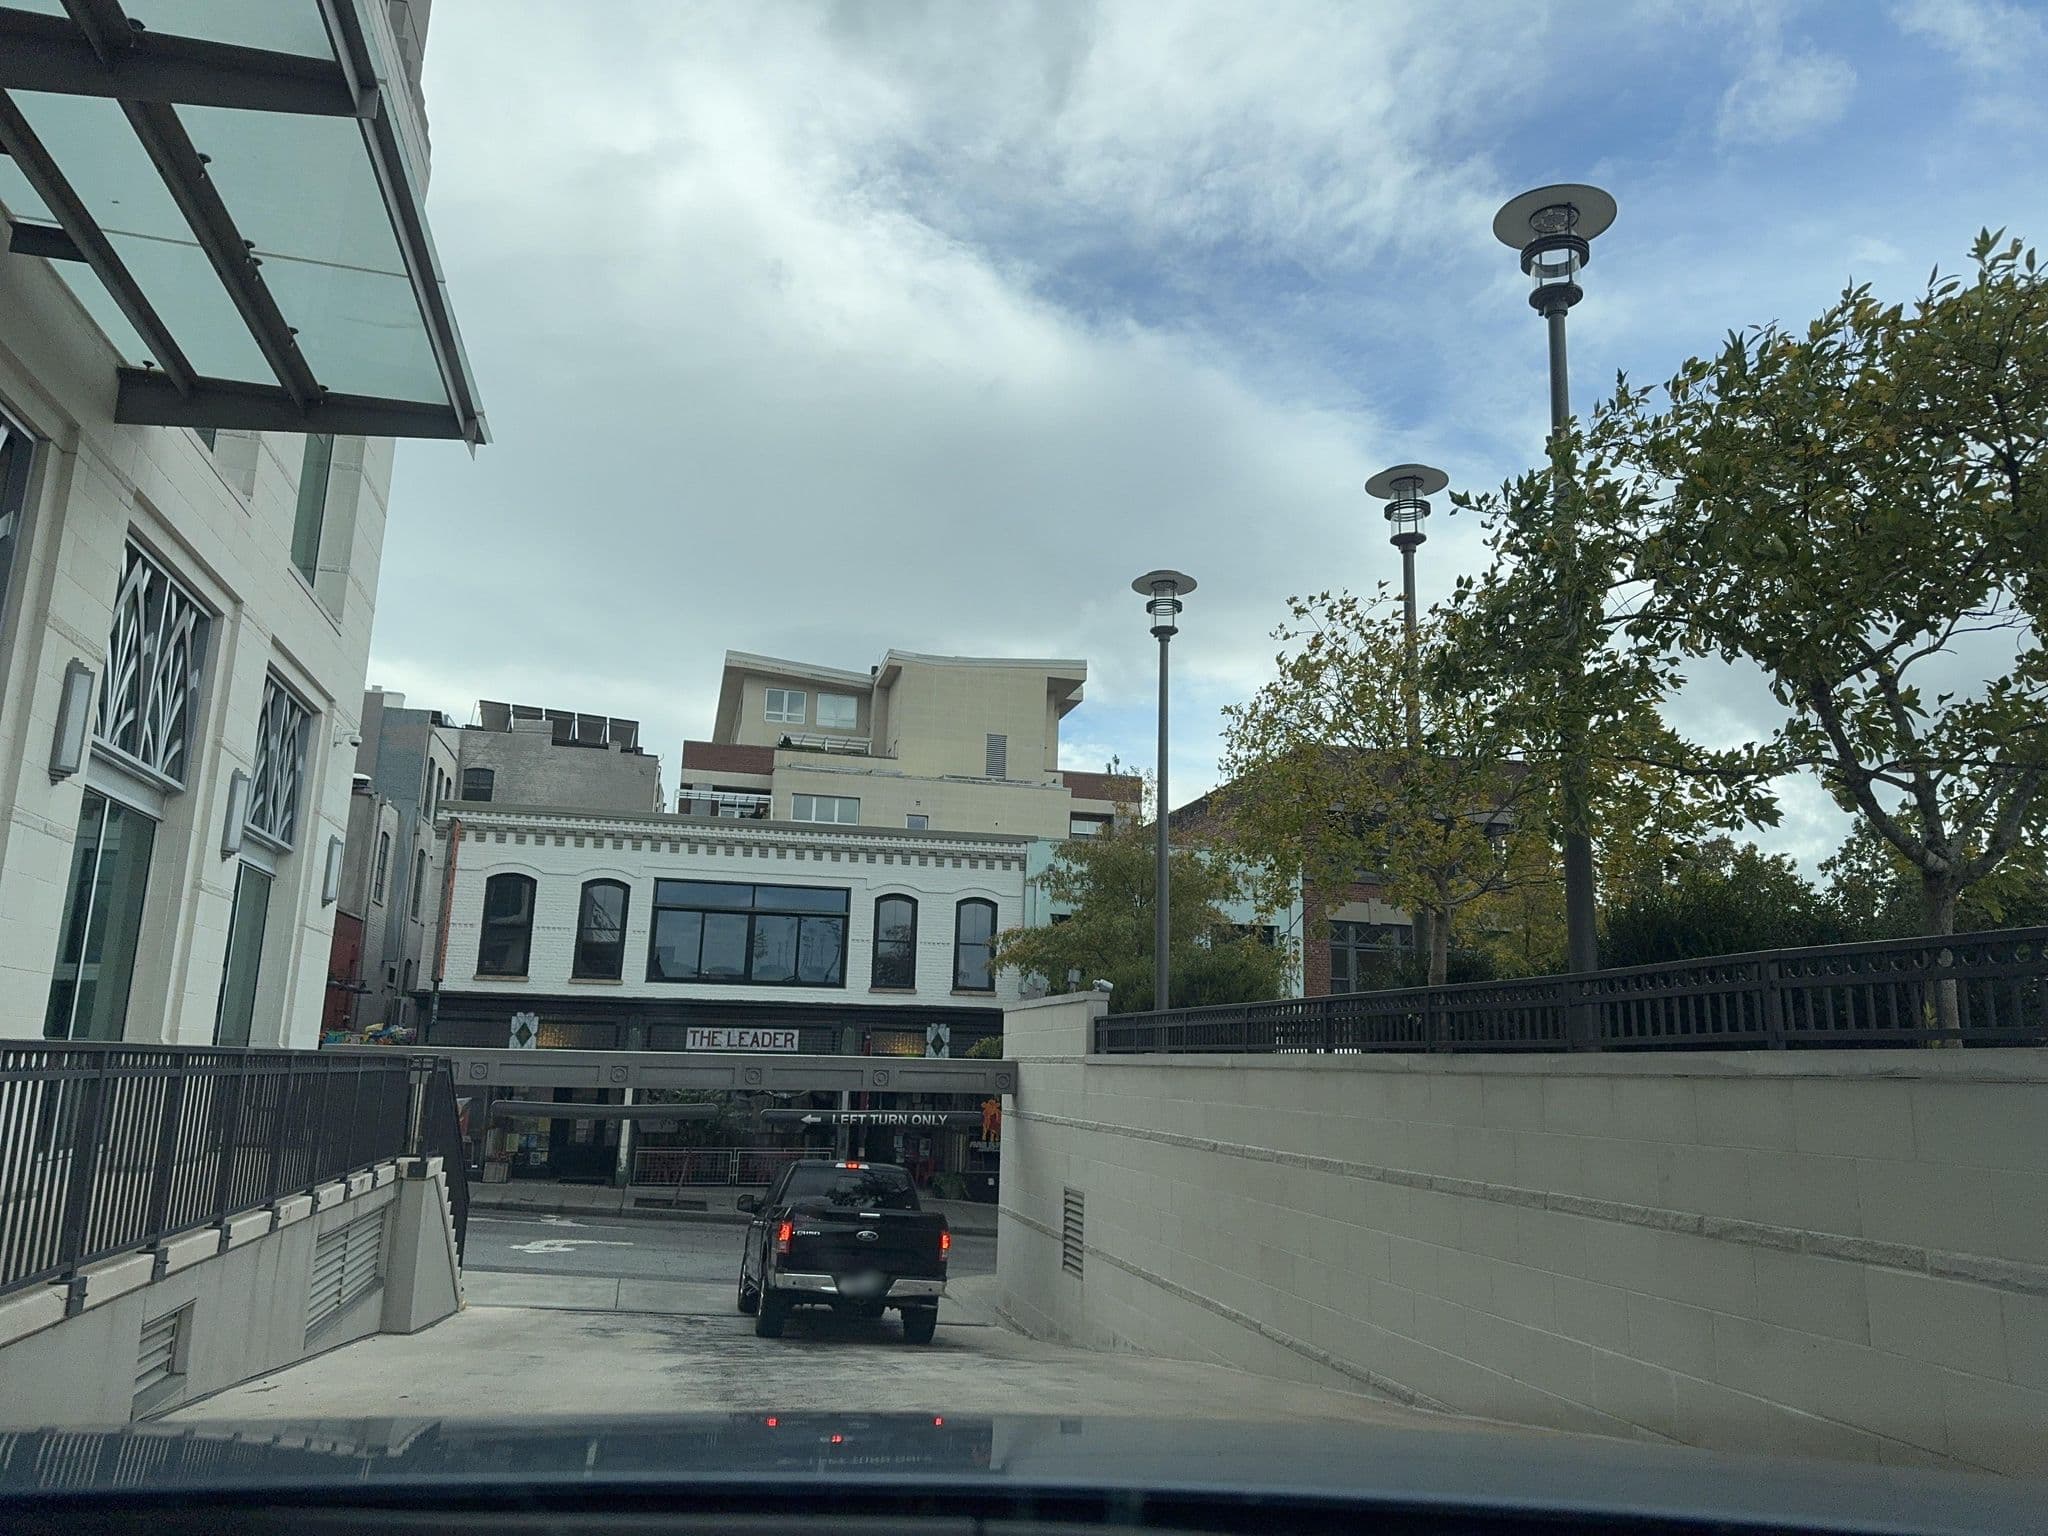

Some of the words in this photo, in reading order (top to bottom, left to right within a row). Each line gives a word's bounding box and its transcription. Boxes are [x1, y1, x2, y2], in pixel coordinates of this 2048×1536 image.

[689, 1030, 722, 1047] THE
[727, 1031, 796, 1048] LEADER
[832, 1114, 867, 1125] LEFT
[870, 1114, 907, 1125] TURN
[911, 1114, 948, 1126] ONLY
